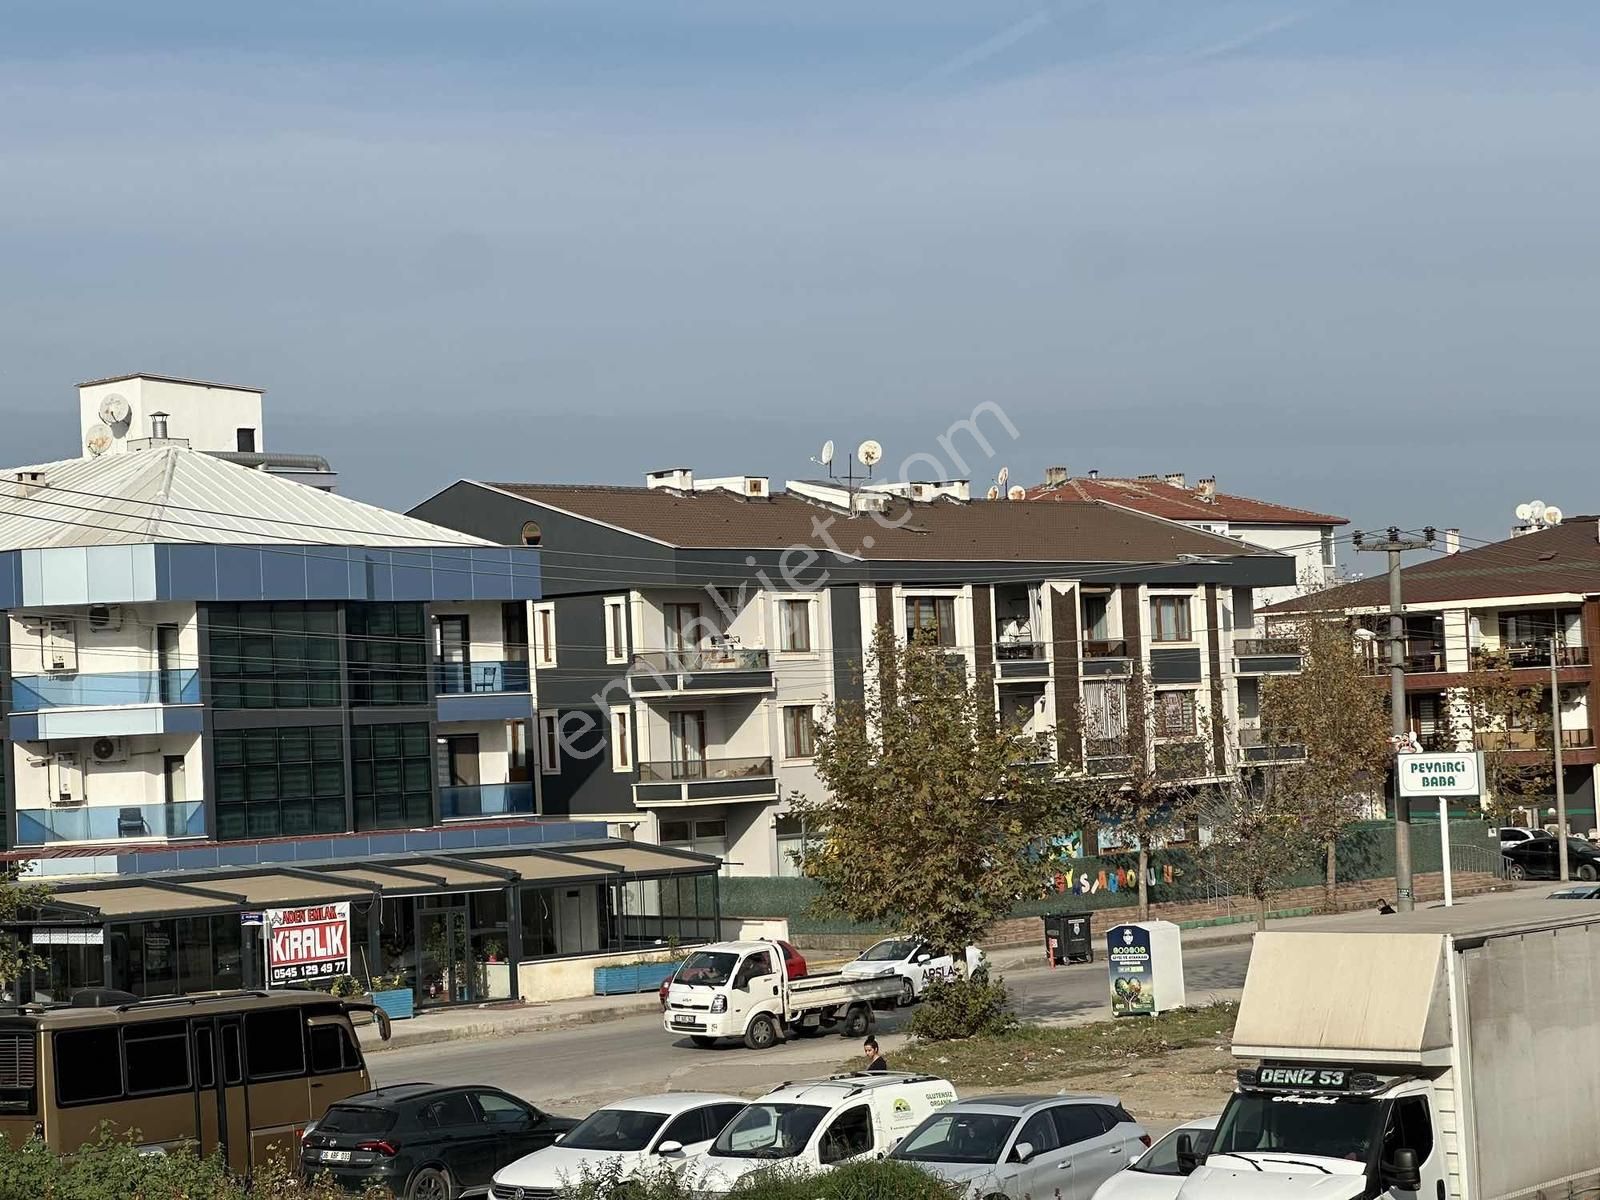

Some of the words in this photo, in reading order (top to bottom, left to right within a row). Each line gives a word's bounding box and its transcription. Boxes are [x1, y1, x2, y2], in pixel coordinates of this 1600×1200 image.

[1422, 776, 1456, 787] BABA
[282, 909, 306, 924] ADEN
[308, 906, 338, 921] EMLAK
[274, 967, 297, 979] 0545
[301, 965, 318, 976] 129
[320, 963, 333, 974] 49
[335, 961, 346, 972] 77
[1260, 1068, 1316, 1085] DENİZ
[1318, 1070, 1345, 1085] 53
